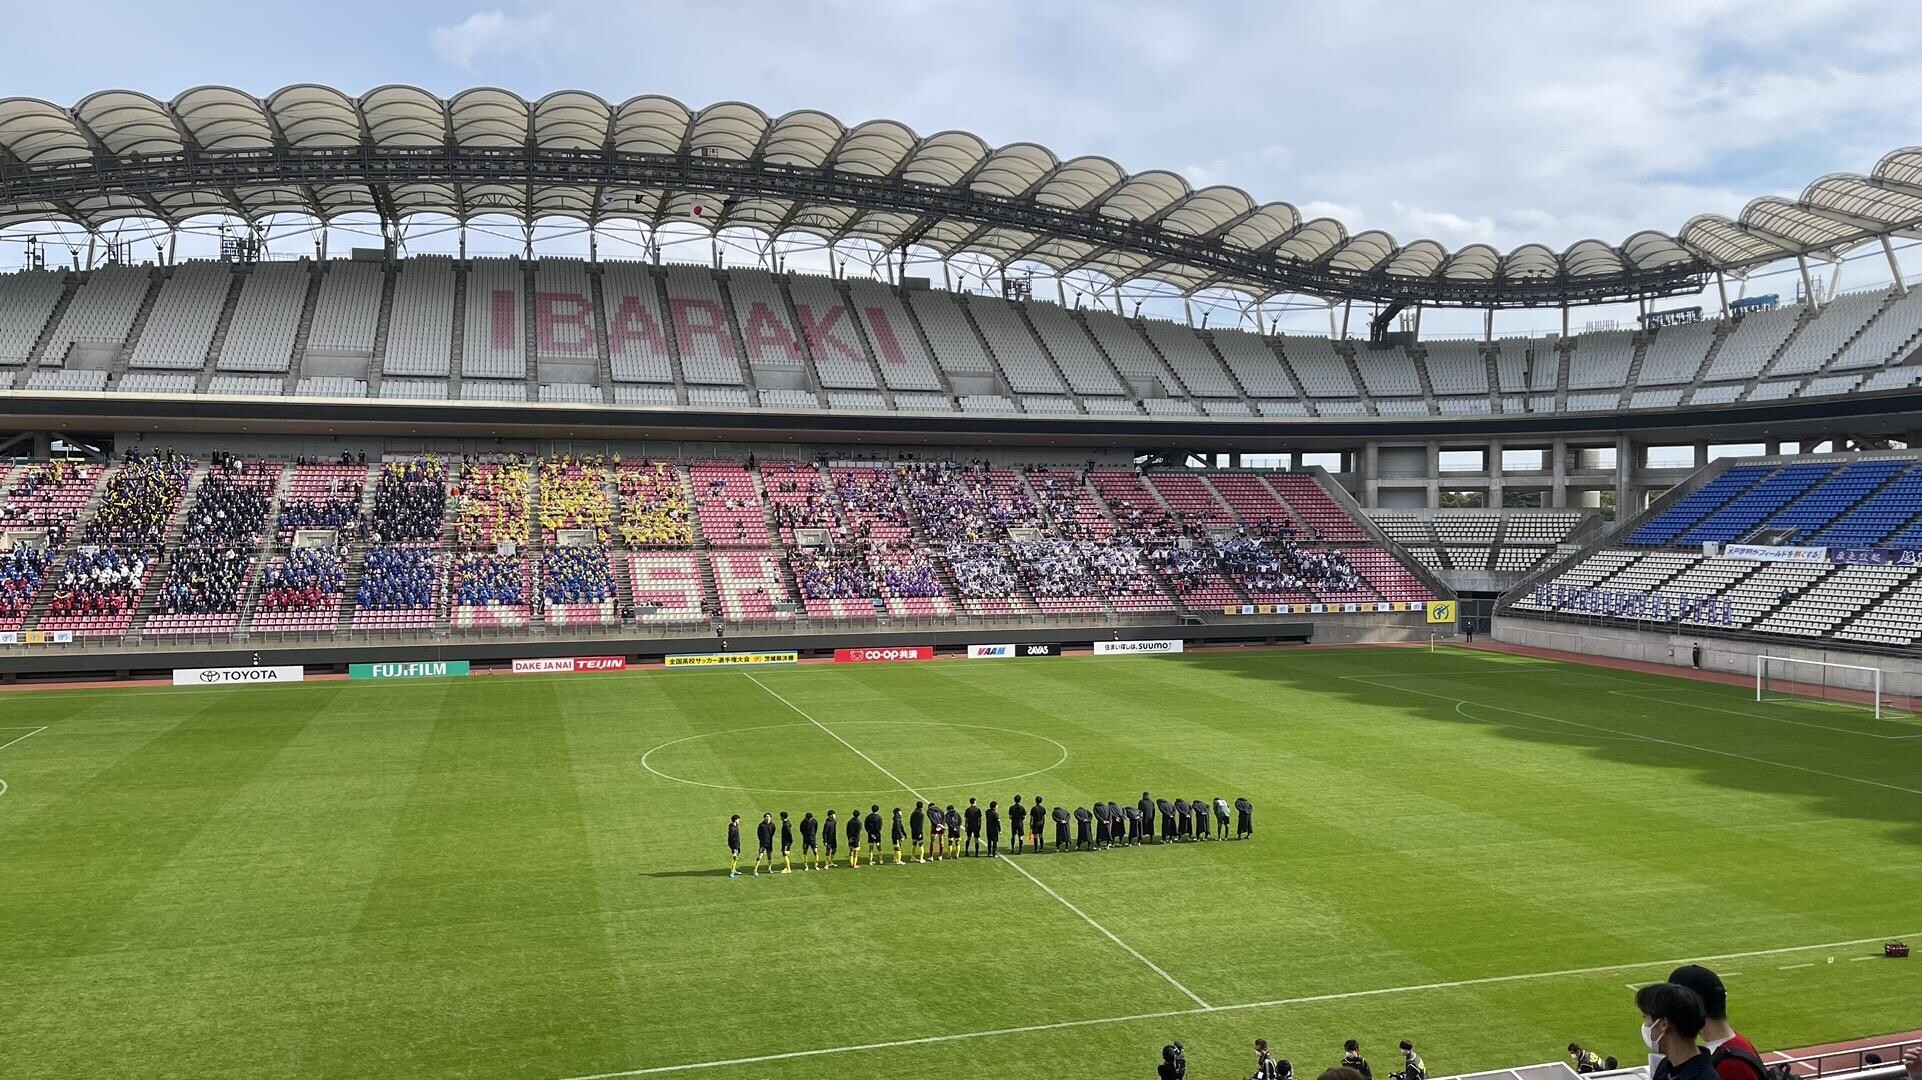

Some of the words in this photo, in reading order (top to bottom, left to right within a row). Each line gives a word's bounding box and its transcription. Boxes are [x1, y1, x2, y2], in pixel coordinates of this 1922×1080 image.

[491, 289, 907, 366] IBARAKI
[977, 647, 1006, 656] VAAM
[372, 662, 447, 677] FUJIFILM
[515, 662, 541, 671] DAKE
[555, 660, 572, 669] NAI
[576, 659, 623, 670] TEIJIN
[222, 670, 277, 680] TOYOTA
